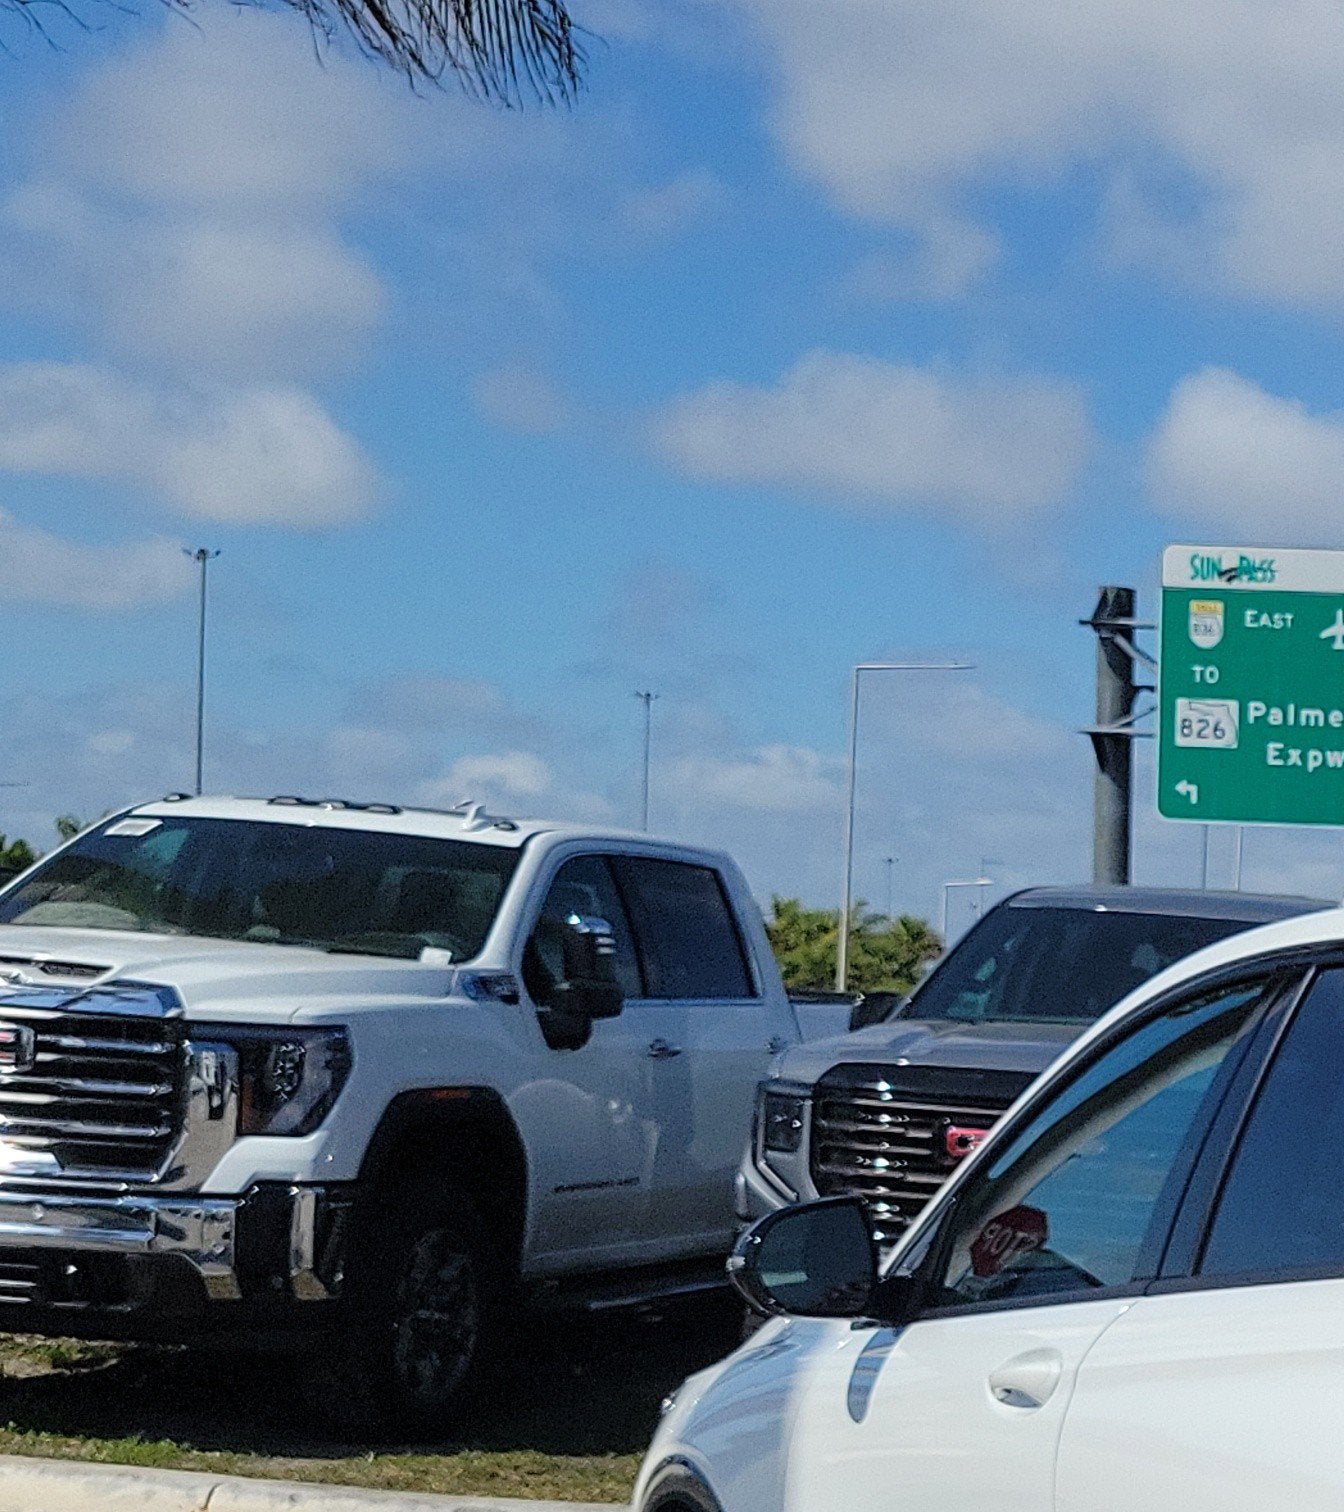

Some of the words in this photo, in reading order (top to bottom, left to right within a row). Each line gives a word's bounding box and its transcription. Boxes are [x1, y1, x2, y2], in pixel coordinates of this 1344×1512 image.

[1244, 608, 1294, 629] EAST
[1191, 665, 1220, 684] TO
[1180, 718, 1226, 740] 826
